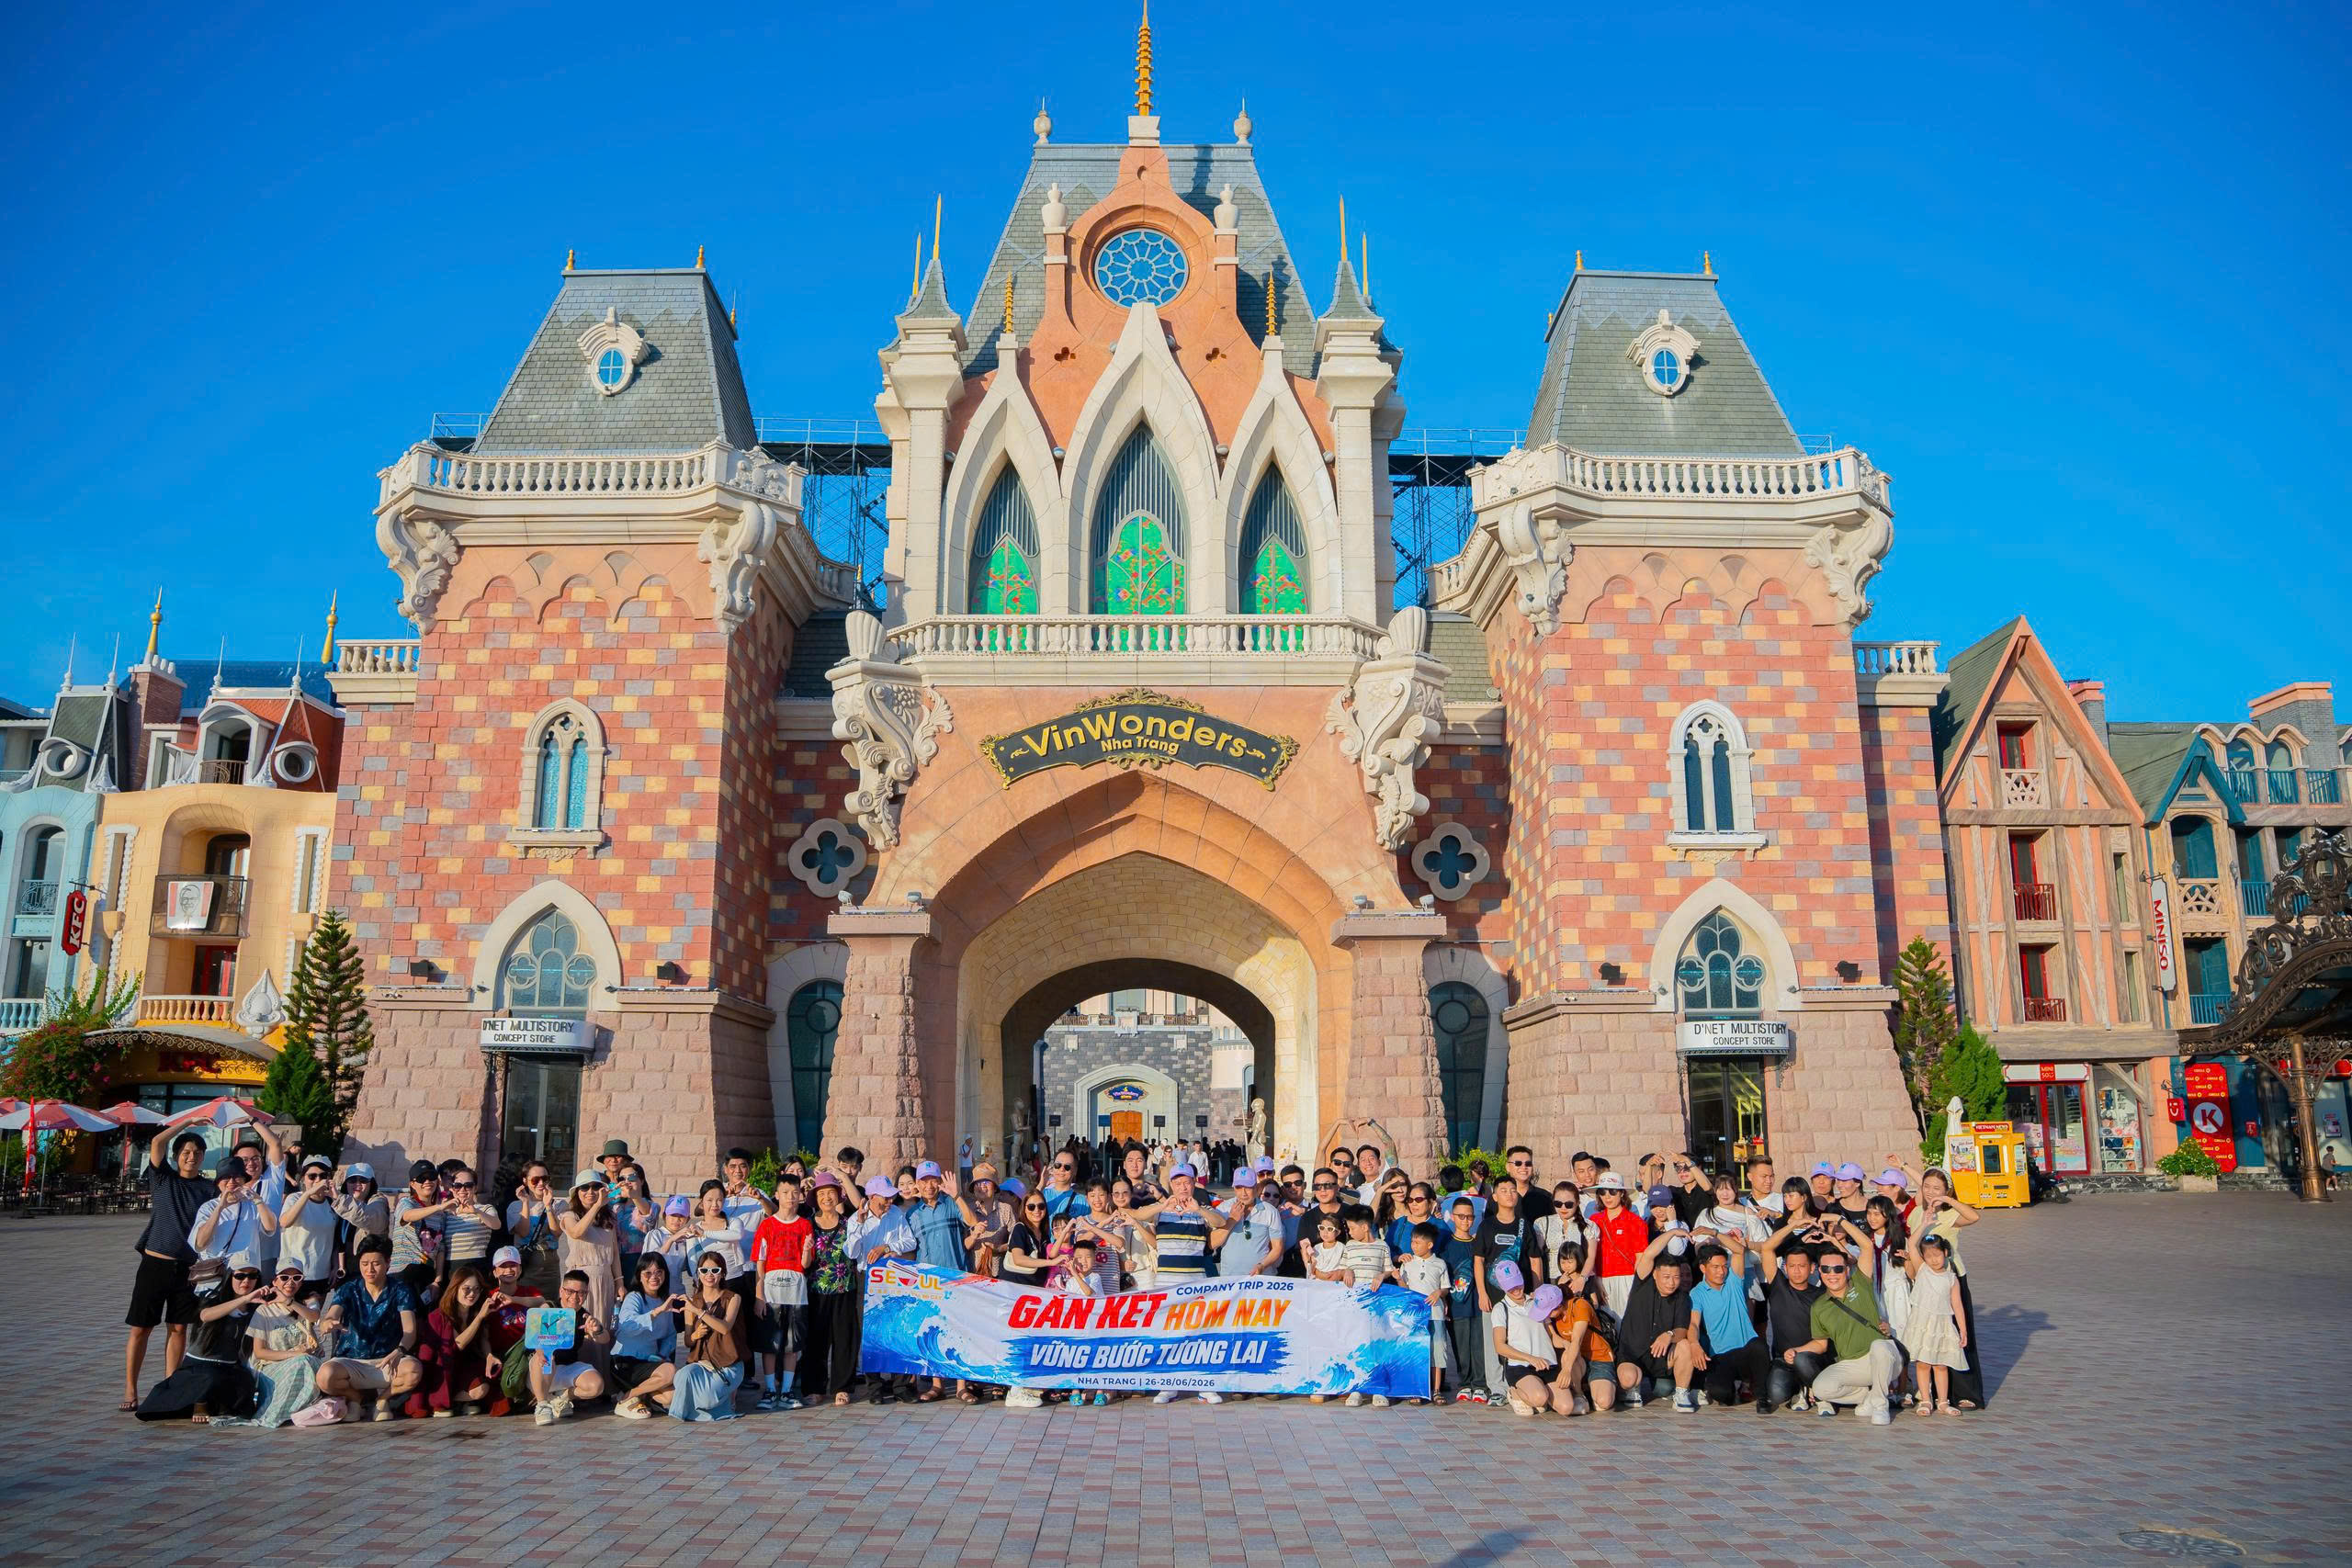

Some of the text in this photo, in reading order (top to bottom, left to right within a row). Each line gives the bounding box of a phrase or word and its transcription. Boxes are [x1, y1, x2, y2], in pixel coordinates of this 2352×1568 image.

[1022, 711, 1247, 758] VinWonders
[1101, 736, 1180, 756] Nha Trang
[69, 897, 85, 948] KFC
[2154, 899, 2169, 971] MINISO
[510, 1021, 576, 1032] MULTISTORY
[1694, 1022, 1787, 1034] D'NET MULTISTORY
[493, 1033, 556, 1043] CONCEPT STORE
[1713, 1036, 1775, 1045] CONCEPT STORE
[2200, 1109, 2221, 1132] K
[1176, 1281, 1295, 1296] COMPANY TRIP 2026
[1162, 1295, 1230, 1331] HÔM
[1235, 1298, 1292, 1327] NAY
[1030, 1338, 1268, 1369] VỮNG BƯỚC TƯƠNG LAI
[1077, 1377, 1100, 1385] NHA
[1102, 1377, 1136, 1386] TRANG
[1145, 1378, 1216, 1387] 26-28/06/2026
